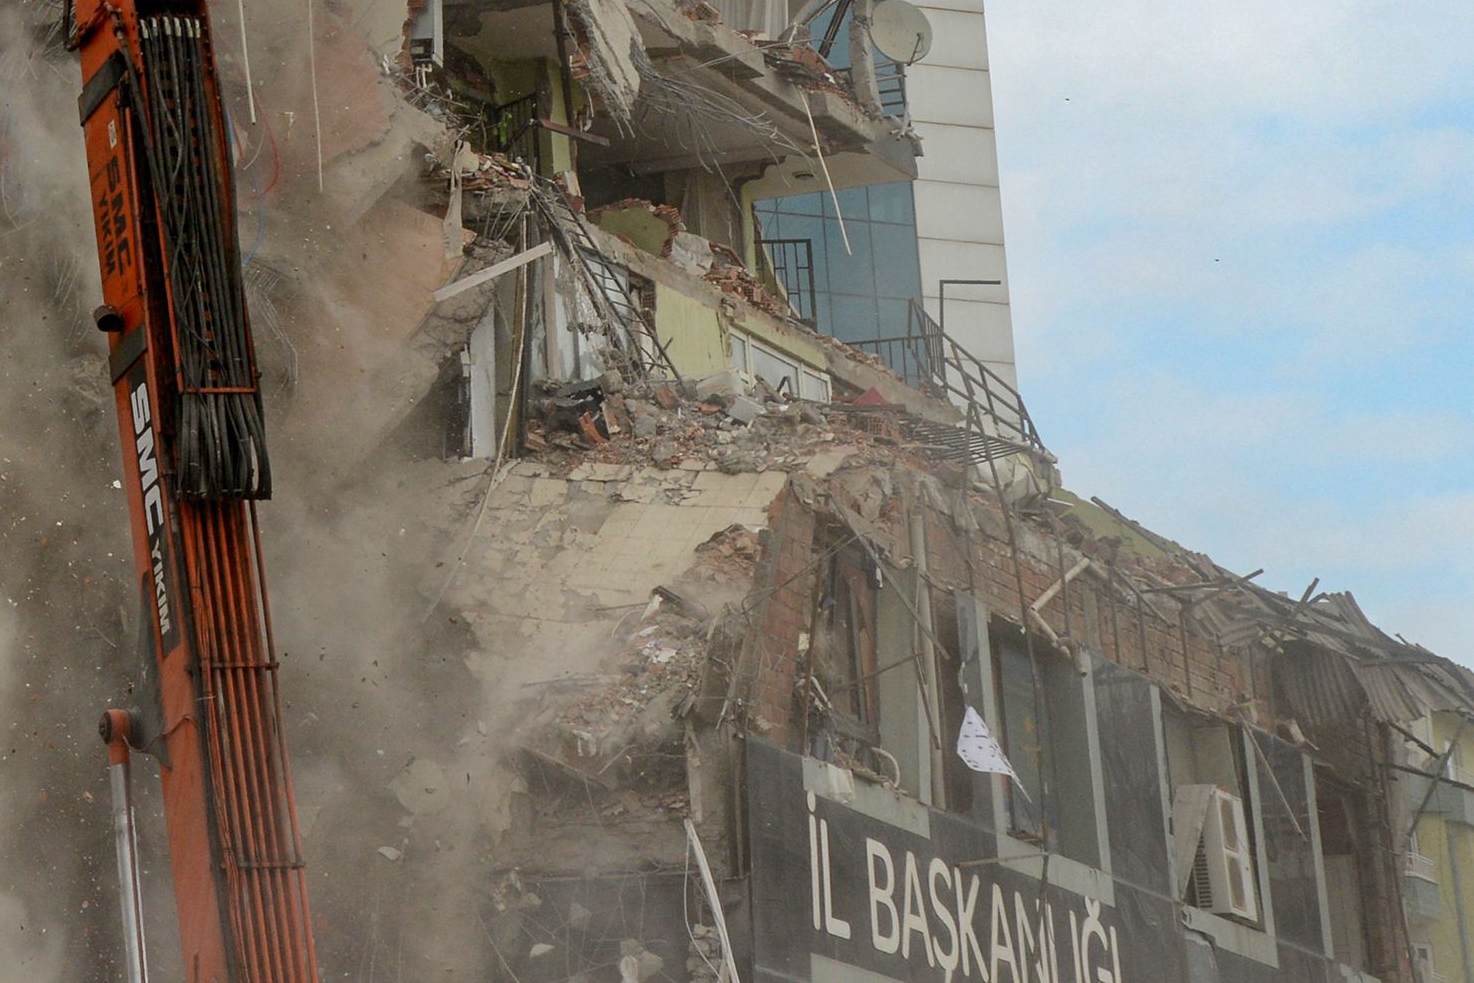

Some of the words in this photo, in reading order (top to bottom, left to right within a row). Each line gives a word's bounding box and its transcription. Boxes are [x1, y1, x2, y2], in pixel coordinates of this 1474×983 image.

[106, 155, 132, 277] SMC
[130, 381, 165, 537] SMC
[151, 538, 171, 635] YIKIM
[806, 791, 852, 940] İL
